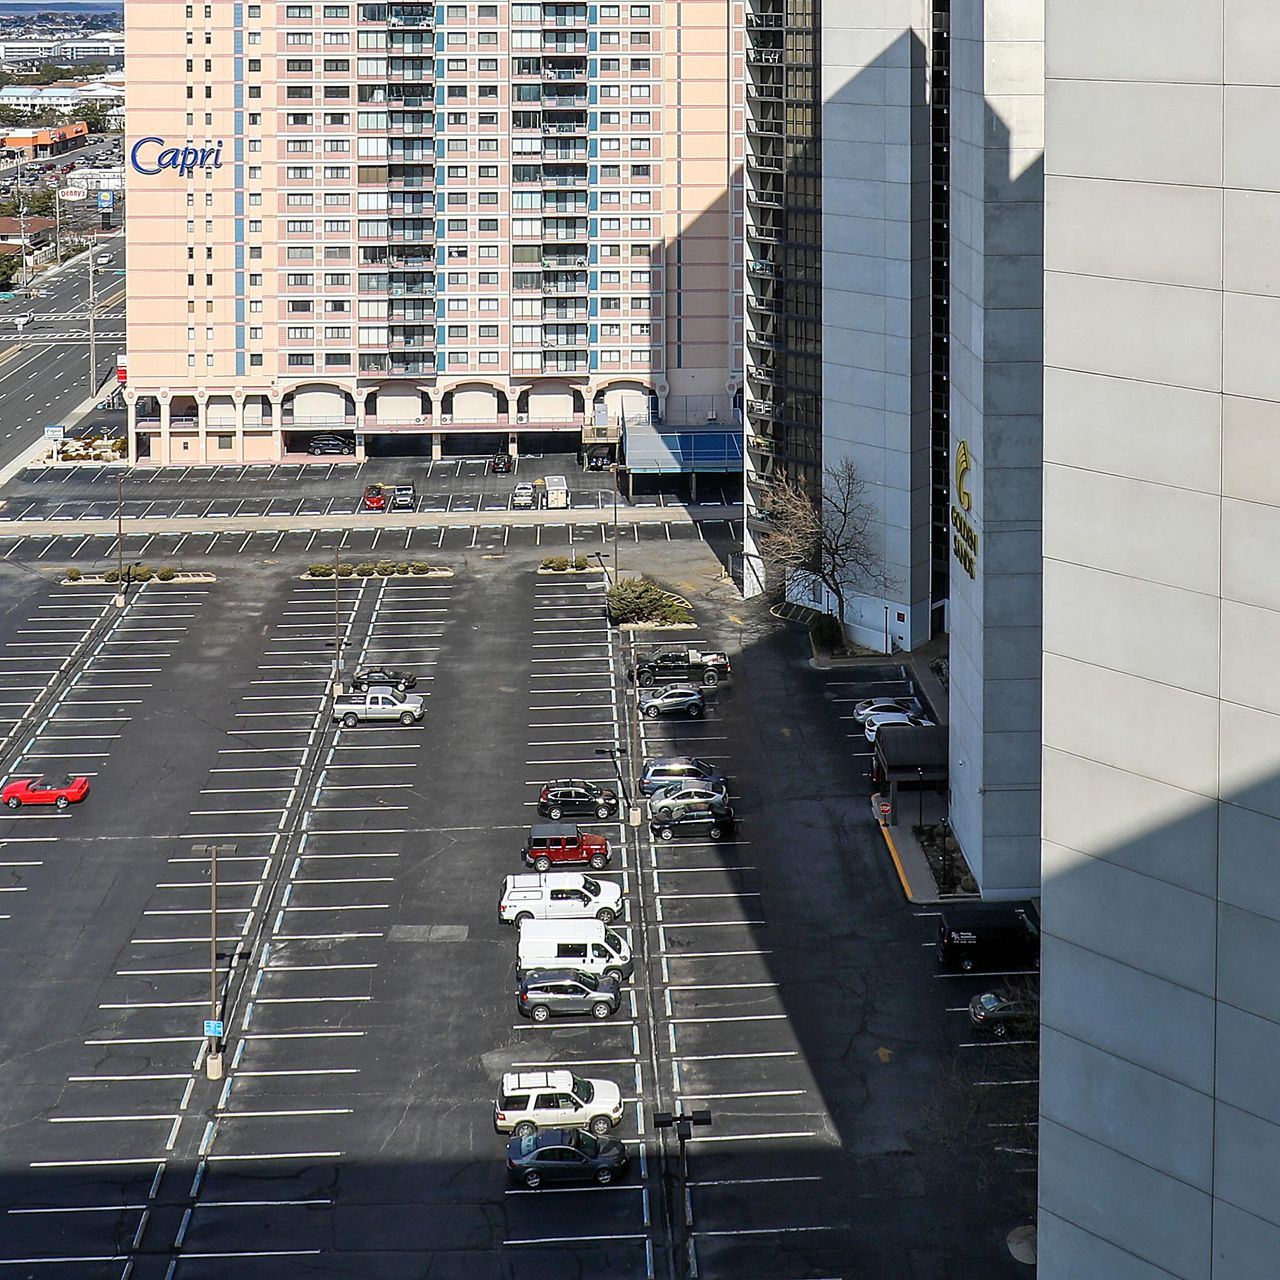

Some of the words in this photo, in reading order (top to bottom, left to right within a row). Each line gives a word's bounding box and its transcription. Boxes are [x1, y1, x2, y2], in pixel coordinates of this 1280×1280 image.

[130, 136, 224, 177] Capri
[61, 189, 85, 198] Denny's
[951, 505, 978, 557] GOLDEN
[953, 534, 976, 581] SANDS
